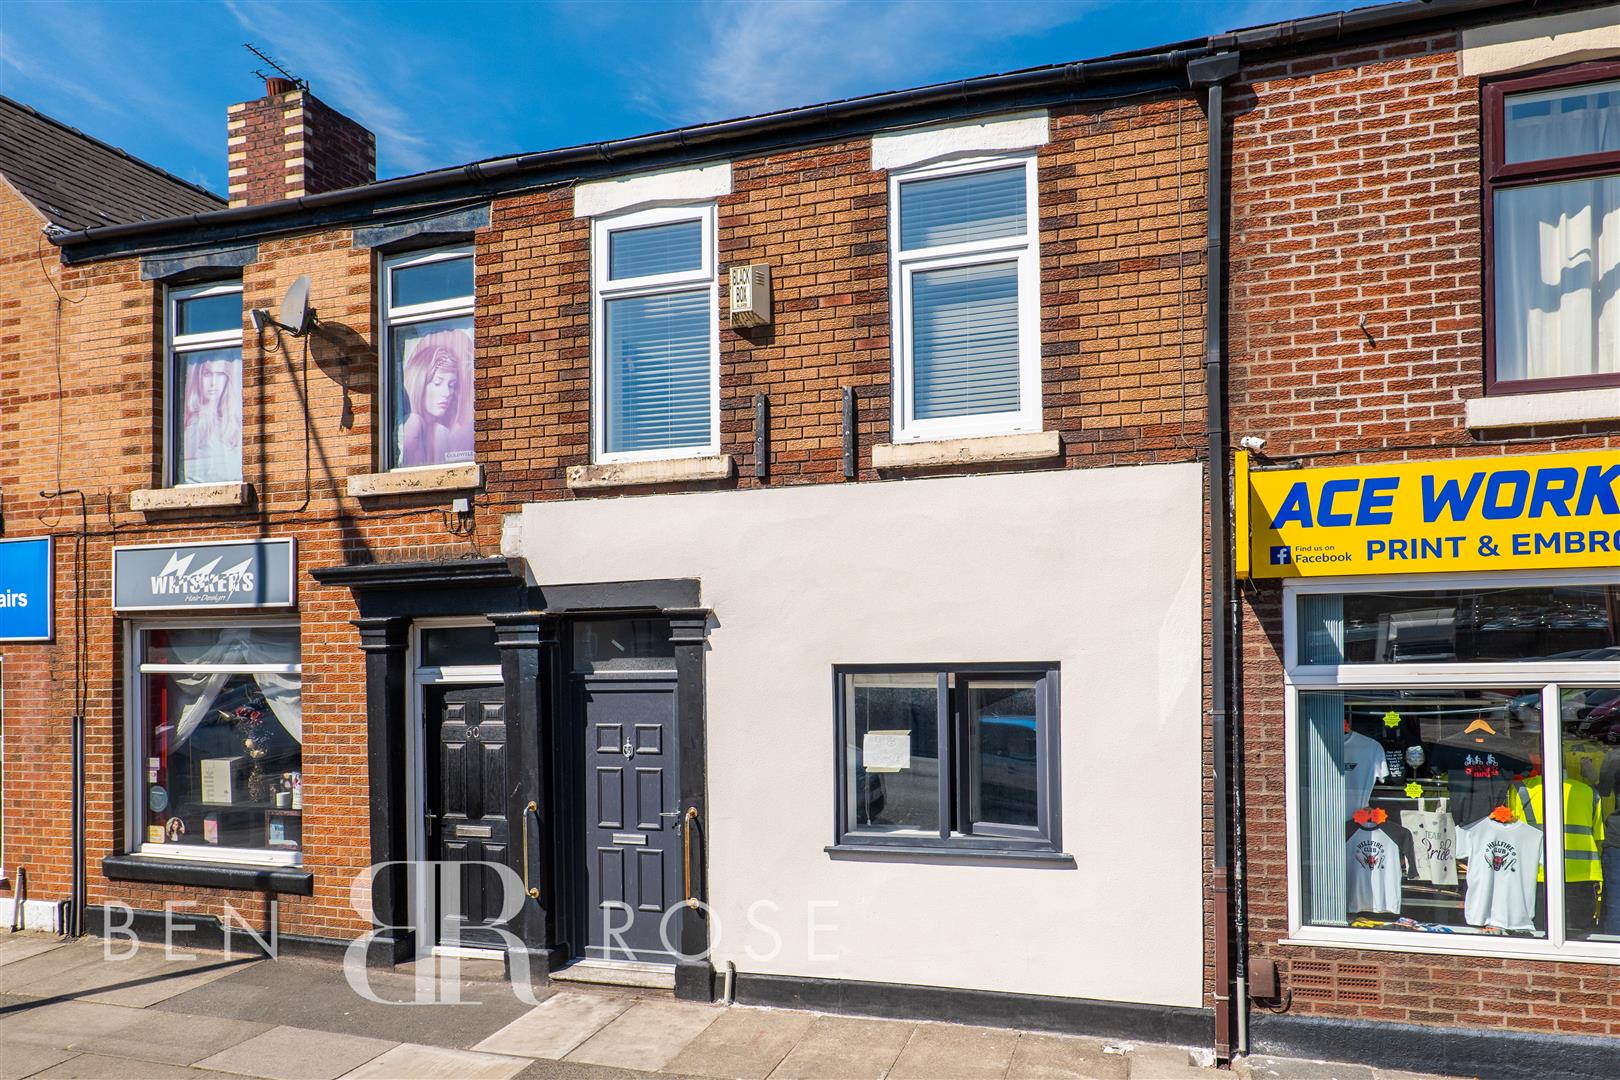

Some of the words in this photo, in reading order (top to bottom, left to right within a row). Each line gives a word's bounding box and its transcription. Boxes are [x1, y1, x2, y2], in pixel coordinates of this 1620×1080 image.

[1269, 476, 1400, 530] ACE
[1421, 464, 1620, 523] WORK
[1367, 536, 1466, 561] PRINT
[1478, 535, 1500, 557] &
[1295, 551, 1352, 563] Facebook
[150, 571, 255, 595] WHISKERS
[0, 588, 28, 608] airs
[184, 593, 201, 602] Hair
[201, 593, 226, 603] Design
[465, 725, 480, 738] 60
[1356, 840, 1384, 850] HELLFIRE
[1421, 837, 1453, 861] Pride
[1487, 840, 1515, 852] HELLFIRE
